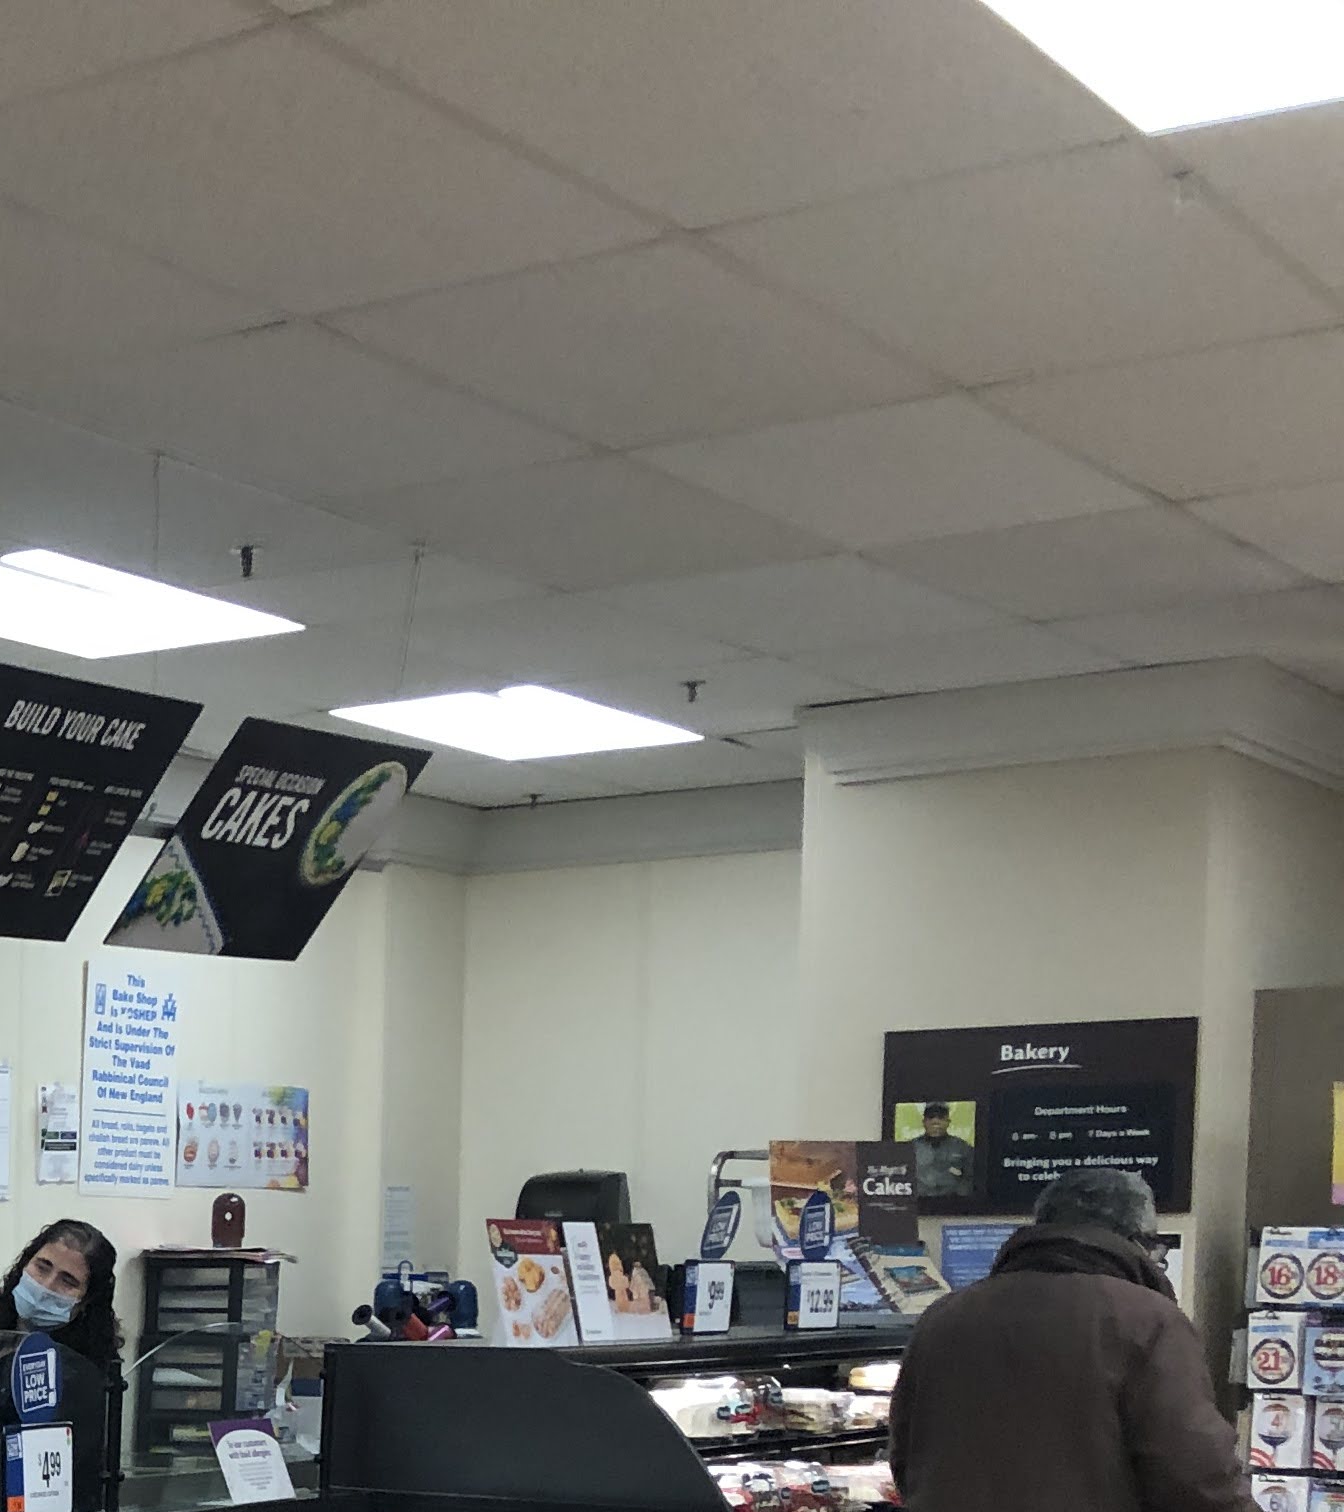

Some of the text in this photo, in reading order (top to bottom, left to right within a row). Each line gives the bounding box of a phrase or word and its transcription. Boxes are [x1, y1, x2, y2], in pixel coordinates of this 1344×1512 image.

[3, 700, 146, 751] BUILD YOUR CAKE
[201, 787, 310, 850] CAKES
[127, 974, 145, 988] This
[136, 992, 158, 1007] Shop
[97, 1021, 113, 1033] And
[125, 1024, 150, 1037] Under
[153, 1027, 169, 1039] The
[89, 1036, 112, 1049] Strict
[114, 1039, 163, 1055] Supervision
[1000, 1043, 1070, 1063] Bakery
[112, 1055, 127, 1068] The
[92, 1070, 169, 1088] Rabbinical Council
[109, 1088, 128, 1100] New
[130, 1089, 163, 1104] England
[1034, 1105, 1128, 1116] Department Hours
[1003, 1157, 1050, 1169] Bringing
[1052, 1159, 1072, 1168] you
[1083, 1155, 1133, 1165] delicious
[1135, 1156, 1159, 1167] way
[1018, 1173, 1030, 1181] to
[862, 1177, 912, 1197] Cakes
[1268, 1265, 1290, 1287] 16
[1315, 1265, 1337, 1287] 18
[1257, 1351, 1281, 1371] 21
[25, 1373, 45, 1389] LOW
